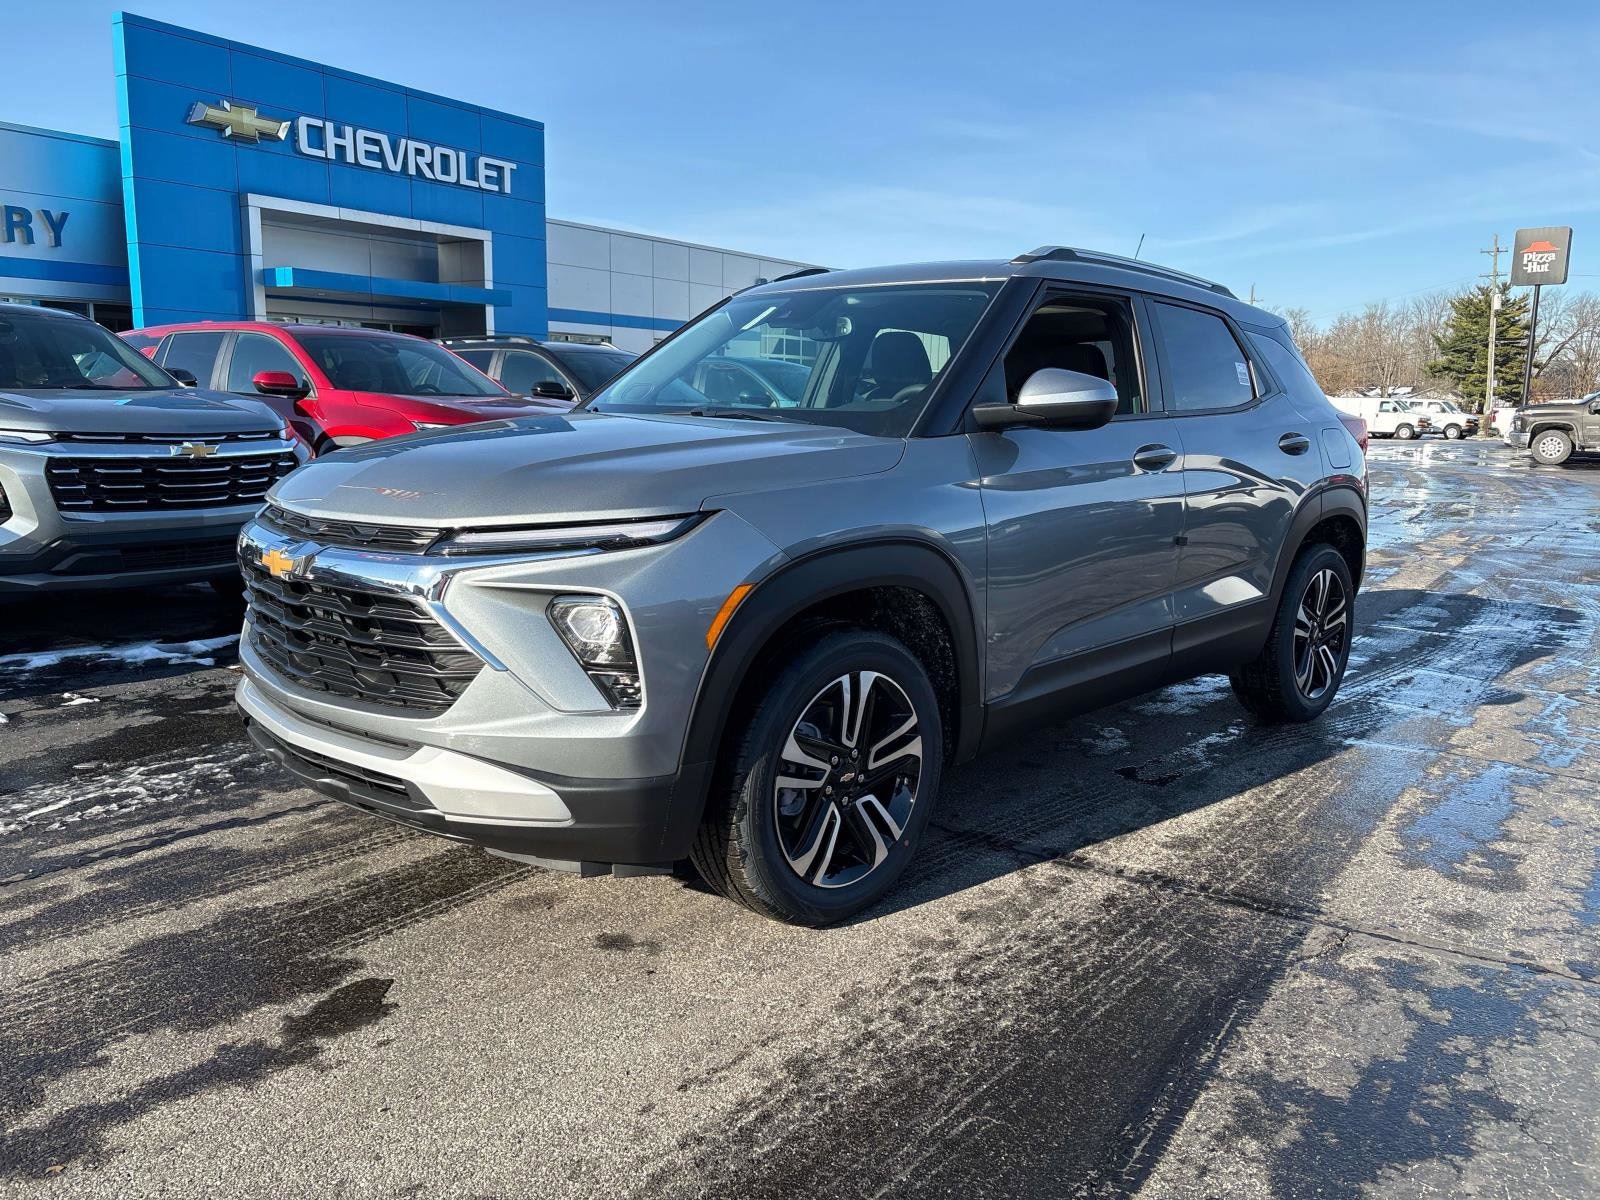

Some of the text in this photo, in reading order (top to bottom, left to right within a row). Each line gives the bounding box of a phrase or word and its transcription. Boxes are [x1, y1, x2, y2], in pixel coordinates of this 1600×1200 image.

[296, 115, 517, 194] CHEVROLET
[1523, 252, 1556, 264] Pizza
[1523, 261, 1550, 273] Hut
